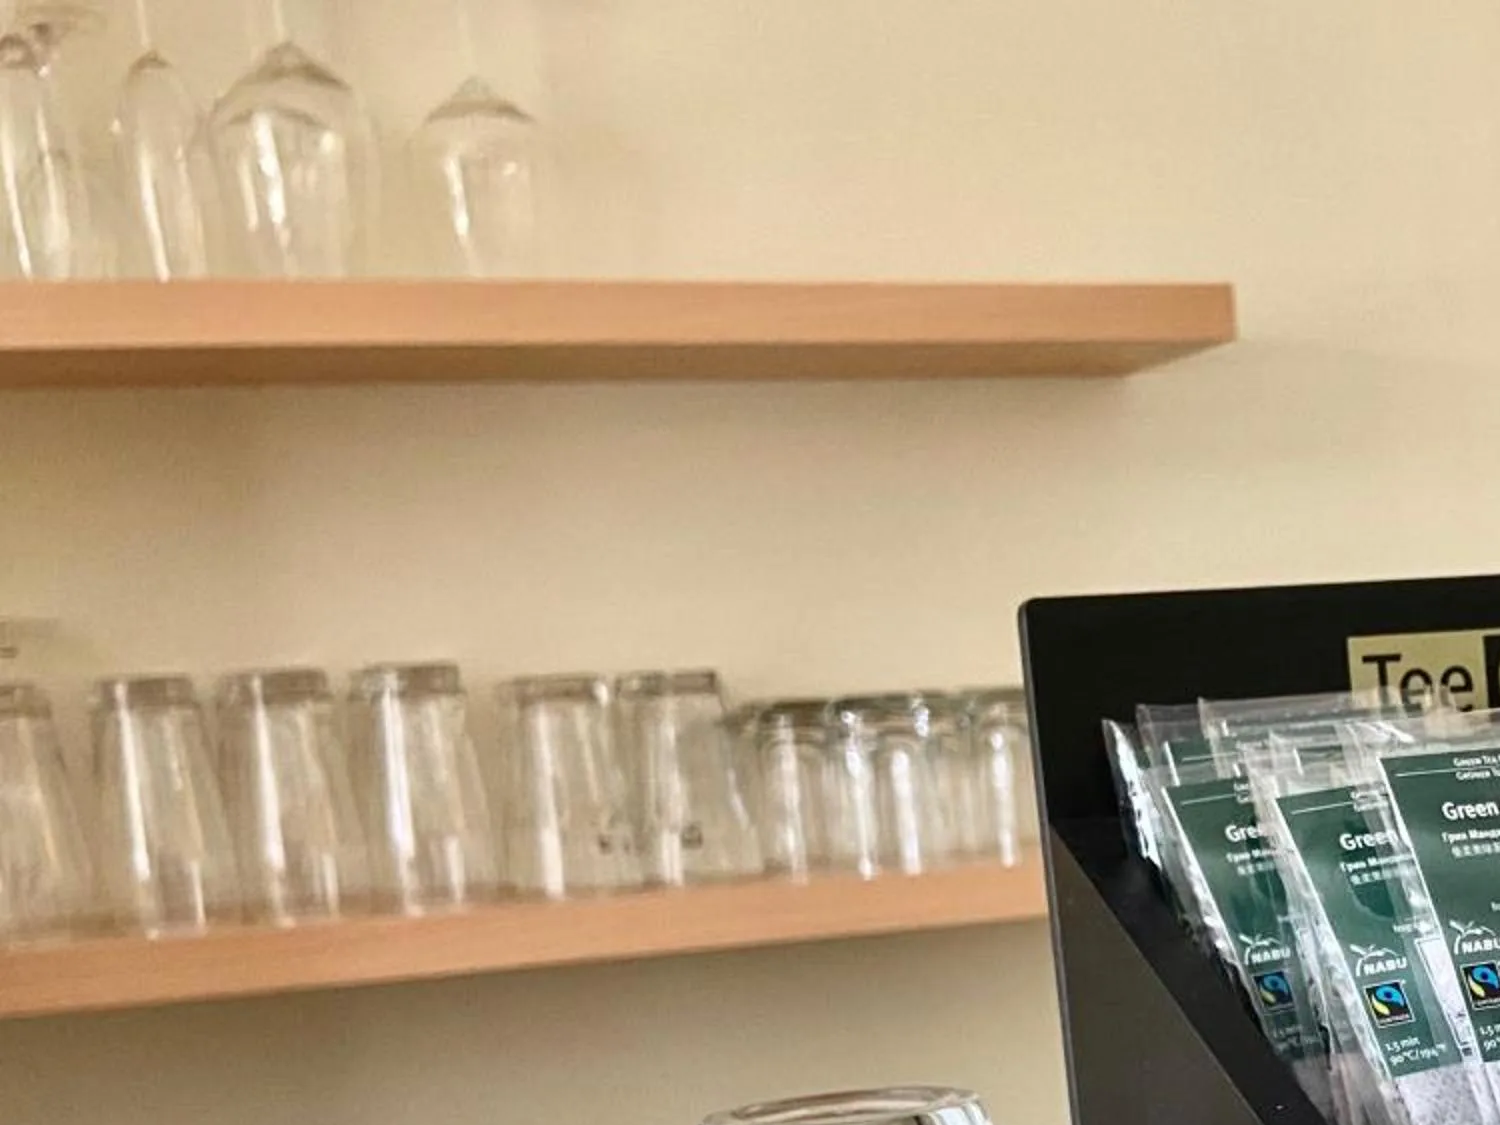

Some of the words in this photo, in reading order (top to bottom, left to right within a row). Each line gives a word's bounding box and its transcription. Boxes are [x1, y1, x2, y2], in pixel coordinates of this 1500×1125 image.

[1362, 652, 1473, 711] Tee
[1442, 801, 1500, 820] Green
[1251, 947, 1291, 963] NABU
[1363, 958, 1407, 974] NABU
